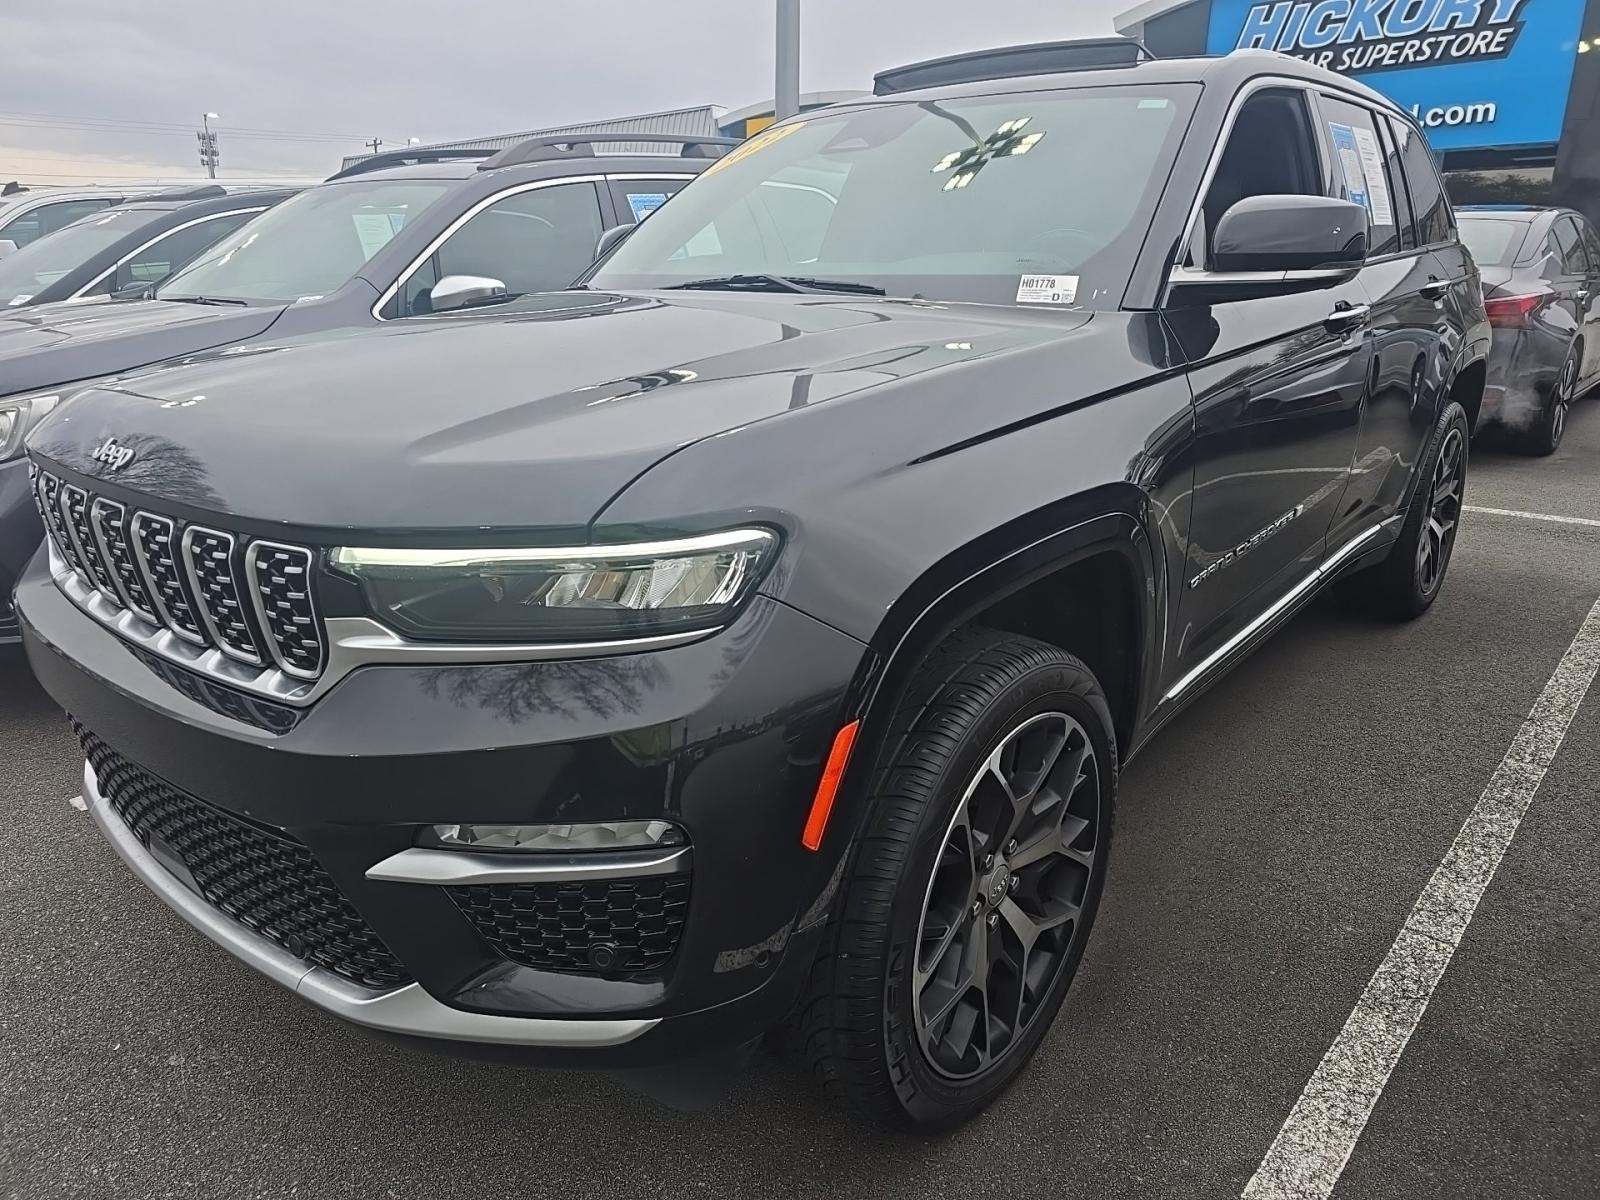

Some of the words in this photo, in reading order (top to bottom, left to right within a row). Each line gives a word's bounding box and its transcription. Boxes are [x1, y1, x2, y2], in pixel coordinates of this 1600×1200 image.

[1299, 51, 1334, 70] AR
[1337, 27, 1515, 70] SUPERSTORE
[1022, 279, 1056, 289] H01778
[1052, 292, 1060, 301] D
[92, 437, 134, 471] Jeep
